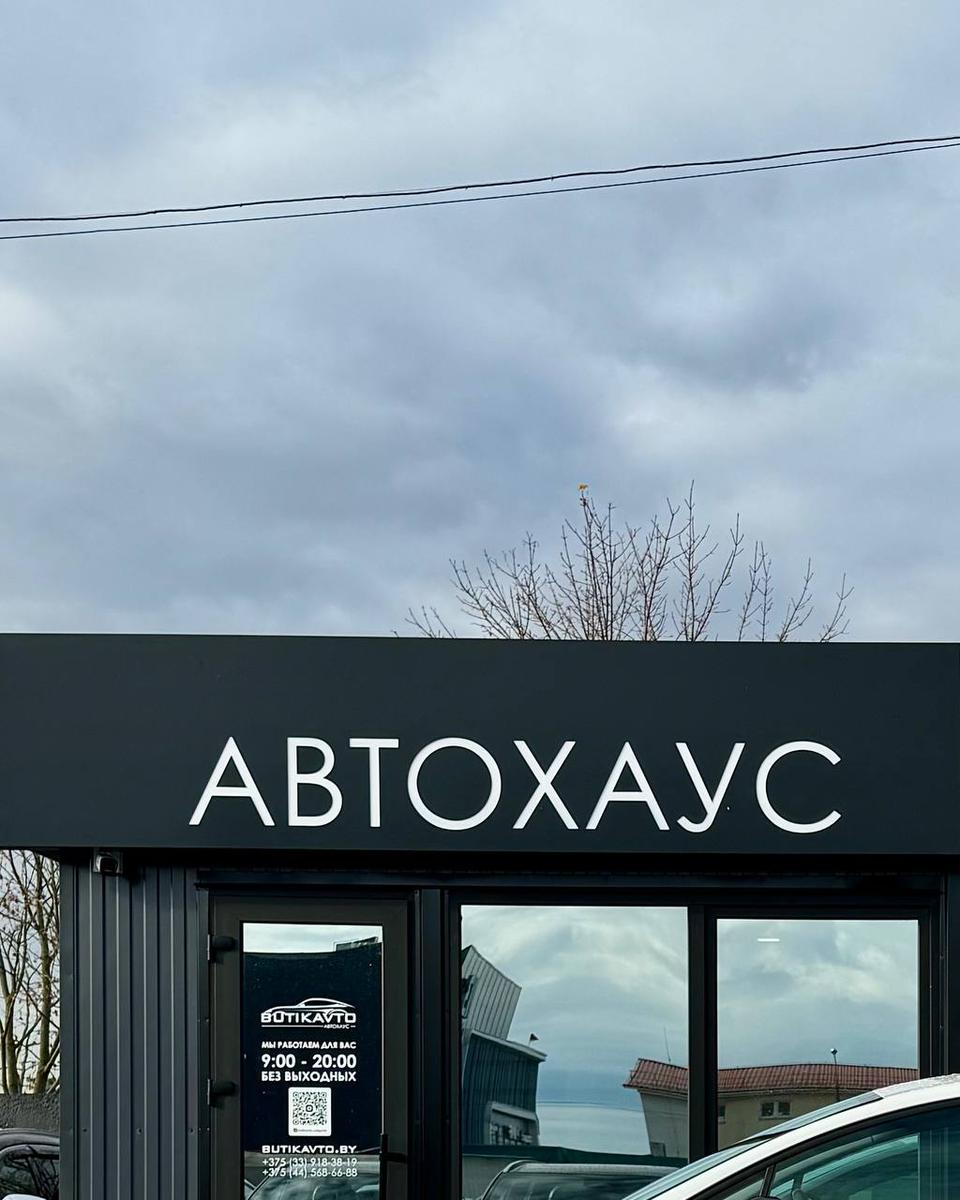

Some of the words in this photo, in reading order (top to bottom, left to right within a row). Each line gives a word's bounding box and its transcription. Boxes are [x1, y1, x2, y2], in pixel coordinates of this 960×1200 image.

[189, 736, 842, 834] АВТОХАУС
[261, 1012, 357, 1023] BUTIKAVTO
[261, 1041, 276, 1049] МЫ
[277, 1041, 320, 1049] РАБОТАЕМ
[320, 1041, 338, 1050] ДЛЯ
[339, 1041, 357, 1049] ВАС
[261, 1053, 296, 1069] 9:00
[312, 1053, 357, 1069] 20:00
[261, 1071, 281, 1082] БЕЗ
[284, 1071, 357, 1083] ВЫХОДНЫХ
[261, 1145, 357, 1154] BUTIKAVTO.BY
[262, 1157, 287, 1167] +375
[289, 1157, 308, 1169] (33)
[310, 1157, 358, 1167] 918-38-19
[262, 1167, 287, 1177] +375
[289, 1167, 308, 1179] (44)
[310, 1167, 358, 1177] 568-66-88
